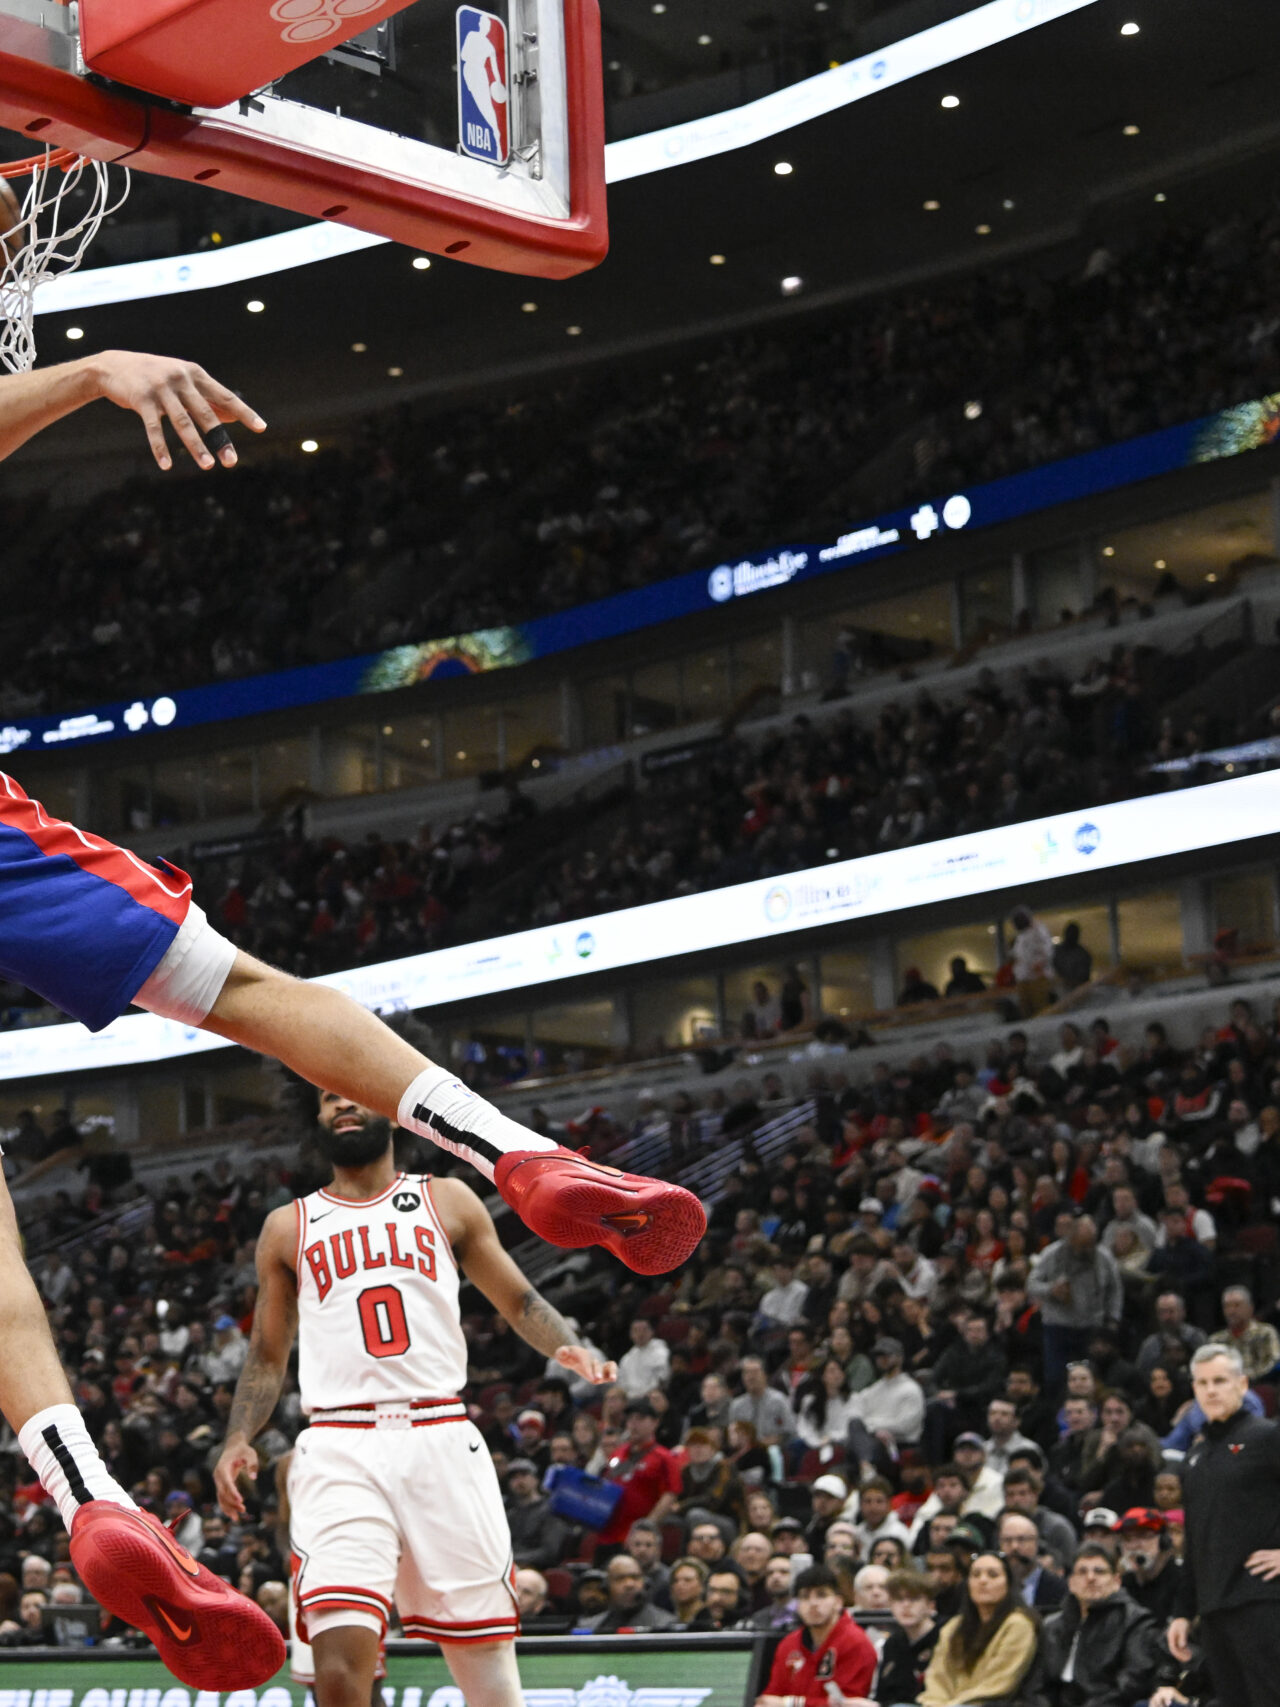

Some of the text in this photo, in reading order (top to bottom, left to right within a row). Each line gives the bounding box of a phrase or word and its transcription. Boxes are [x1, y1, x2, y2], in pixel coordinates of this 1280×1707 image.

[467, 122, 492, 152] NBA
[305, 1223, 437, 1303] BULLS
[357, 1284, 411, 1358] 0
